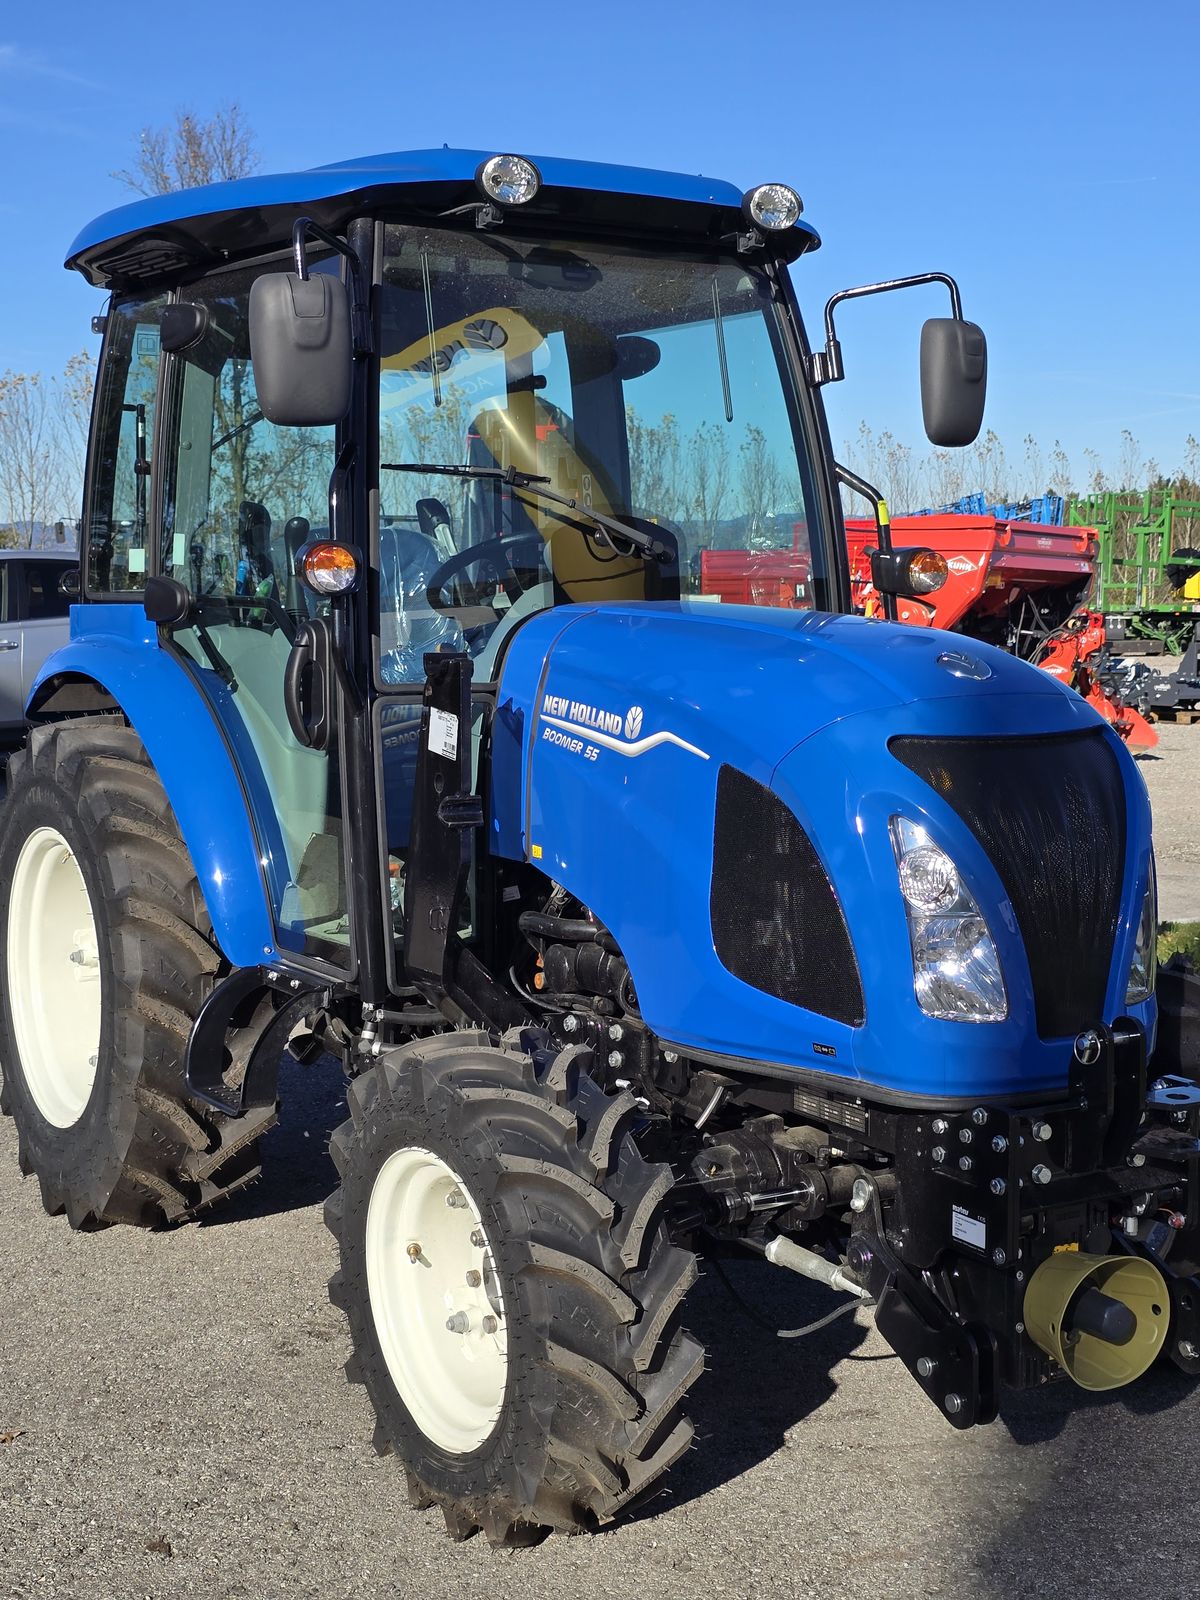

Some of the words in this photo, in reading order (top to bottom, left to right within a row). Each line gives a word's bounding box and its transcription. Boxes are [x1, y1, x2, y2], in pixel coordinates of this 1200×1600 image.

[543, 694, 569, 718] NEW
[569, 701, 623, 736] HOLLAND
[542, 727, 584, 755] BOOMER
[584, 745, 600, 762] 55
